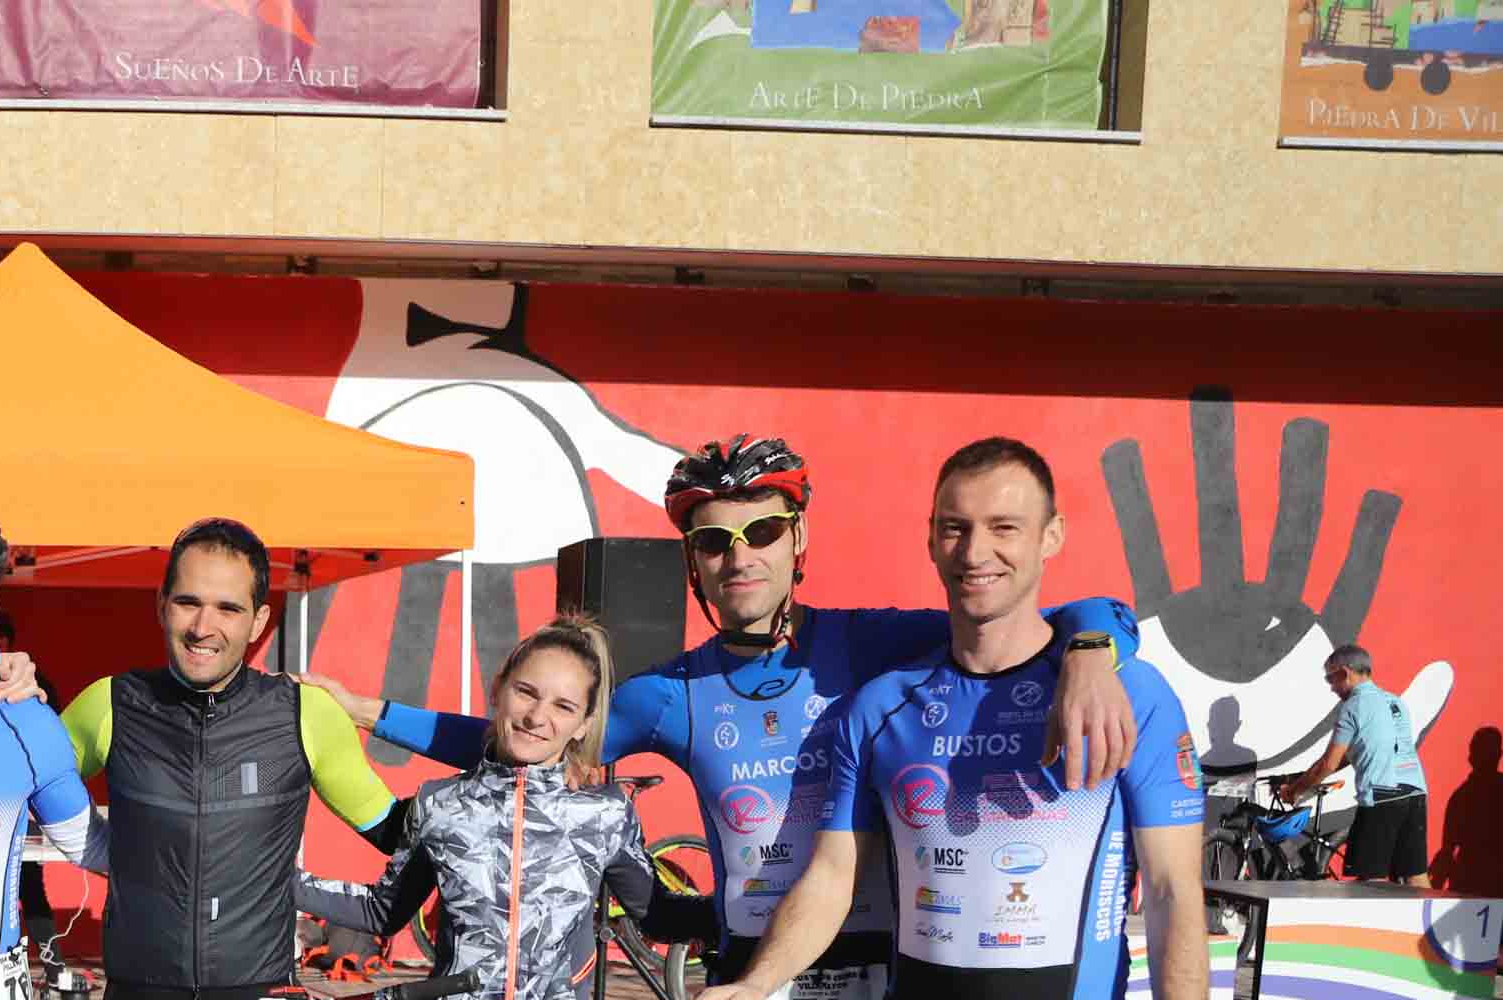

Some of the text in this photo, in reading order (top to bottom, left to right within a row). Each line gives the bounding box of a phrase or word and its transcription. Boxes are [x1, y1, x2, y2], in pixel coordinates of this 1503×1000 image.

[932, 732, 1022, 758] BUSTOS
[732, 749, 829, 782] MARCOS
[759, 843, 790, 861] MSC
[934, 847, 964, 867] MSC
[1476, 905, 1490, 939] 1
